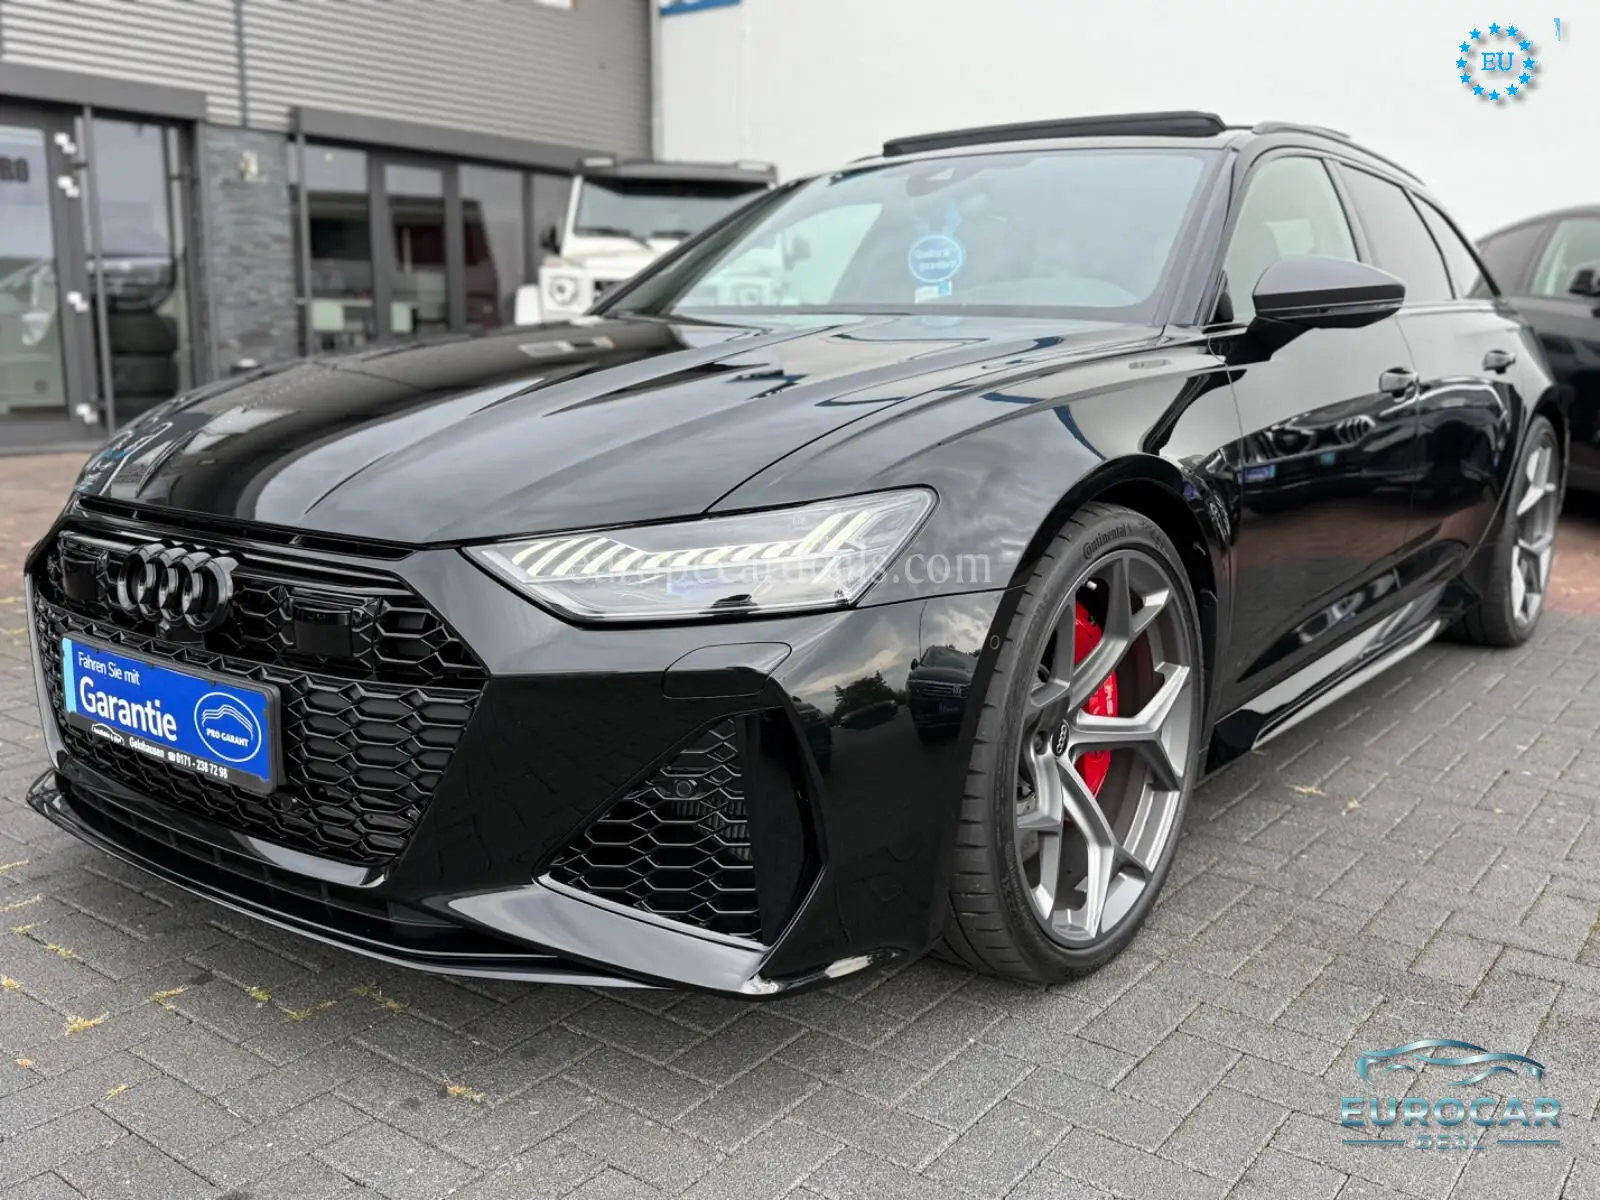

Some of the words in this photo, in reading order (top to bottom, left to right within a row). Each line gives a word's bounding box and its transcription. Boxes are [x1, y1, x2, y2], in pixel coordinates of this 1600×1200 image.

[1083, 523, 1128, 560] Continental
[78, 651, 107, 676] Fahren
[108, 662, 123, 680] Sie
[124, 669, 141, 686] mit
[79, 676, 178, 742] Garantie
[206, 727, 221, 740] PRO
[221, 732, 249, 747] GARANT
[176, 752, 191, 767] 0171
[210, 763, 219, 776] 72
